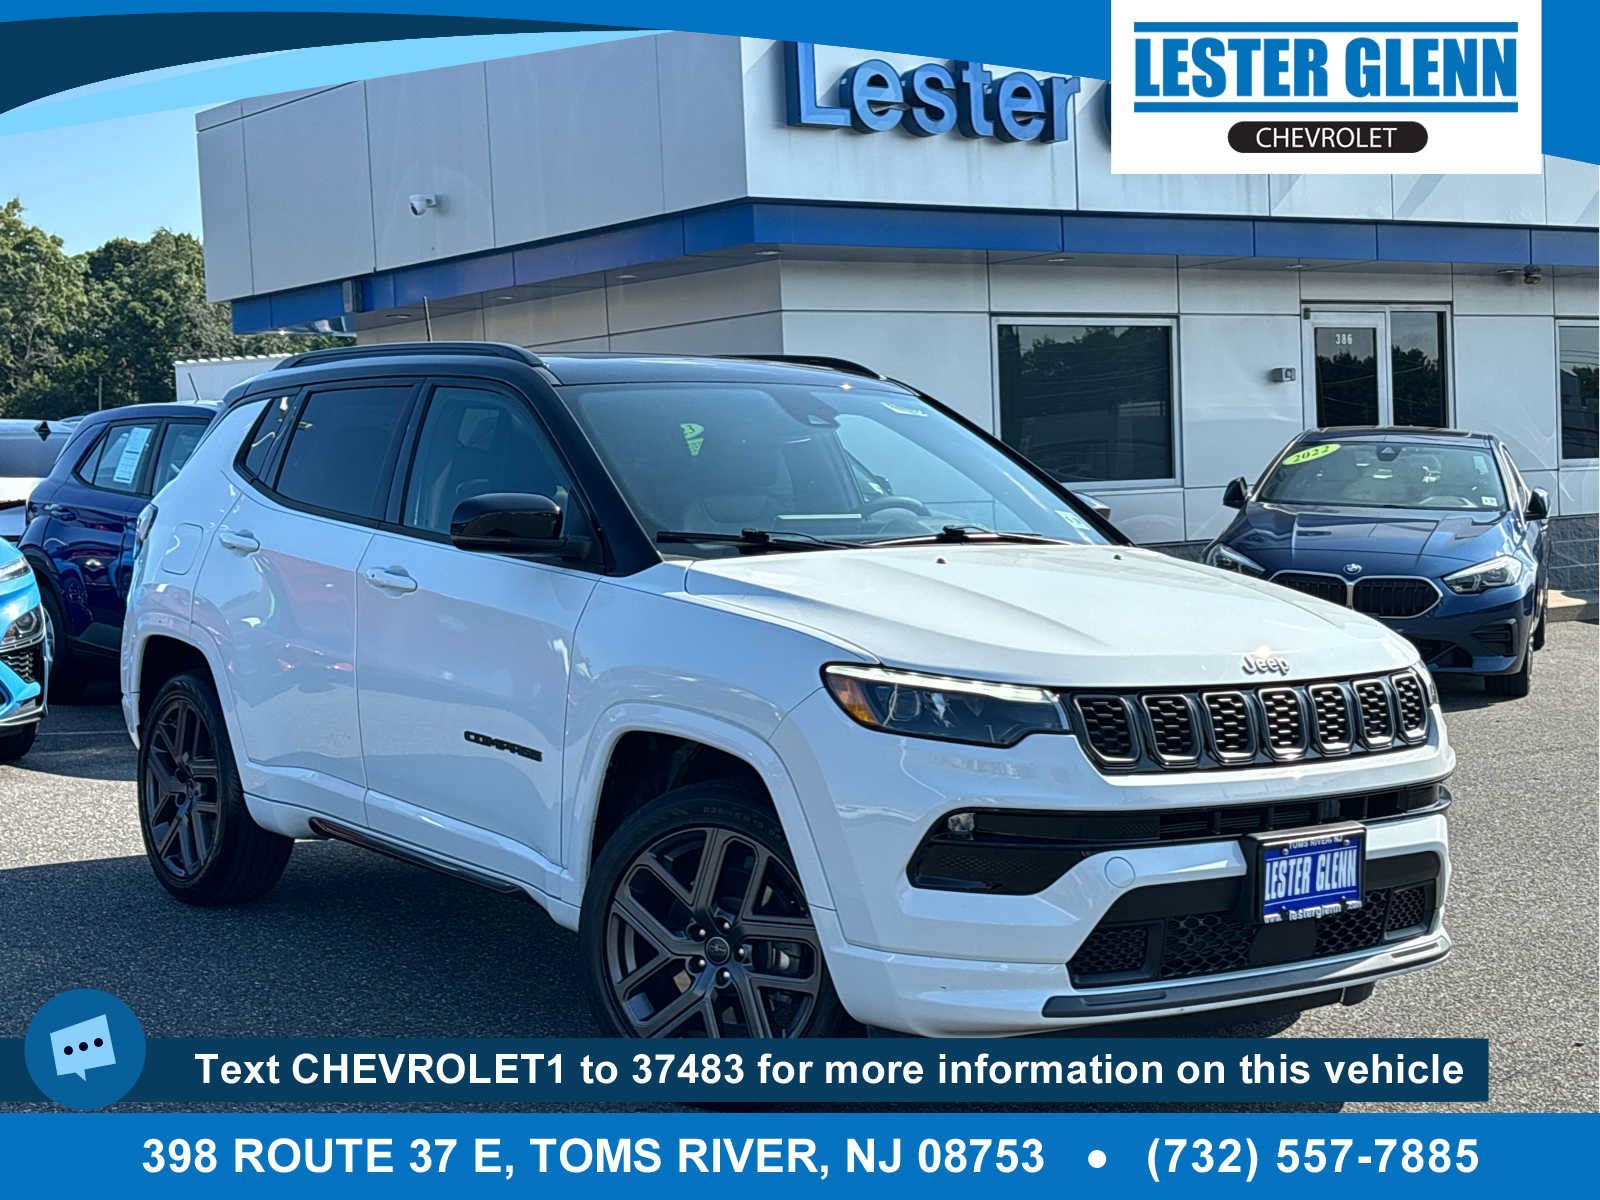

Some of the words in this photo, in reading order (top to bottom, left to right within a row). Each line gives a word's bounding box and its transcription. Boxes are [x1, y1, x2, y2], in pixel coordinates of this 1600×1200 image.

[785, 41, 1081, 143] Lester
[1335, 333, 1353, 345] 386
[1293, 445, 1331, 463] 2022
[1241, 654, 1290, 677] Jeep
[463, 730, 543, 763] COMPASS
[1264, 855, 1312, 901] LESTER
[1315, 848, 1358, 892] GLENN
